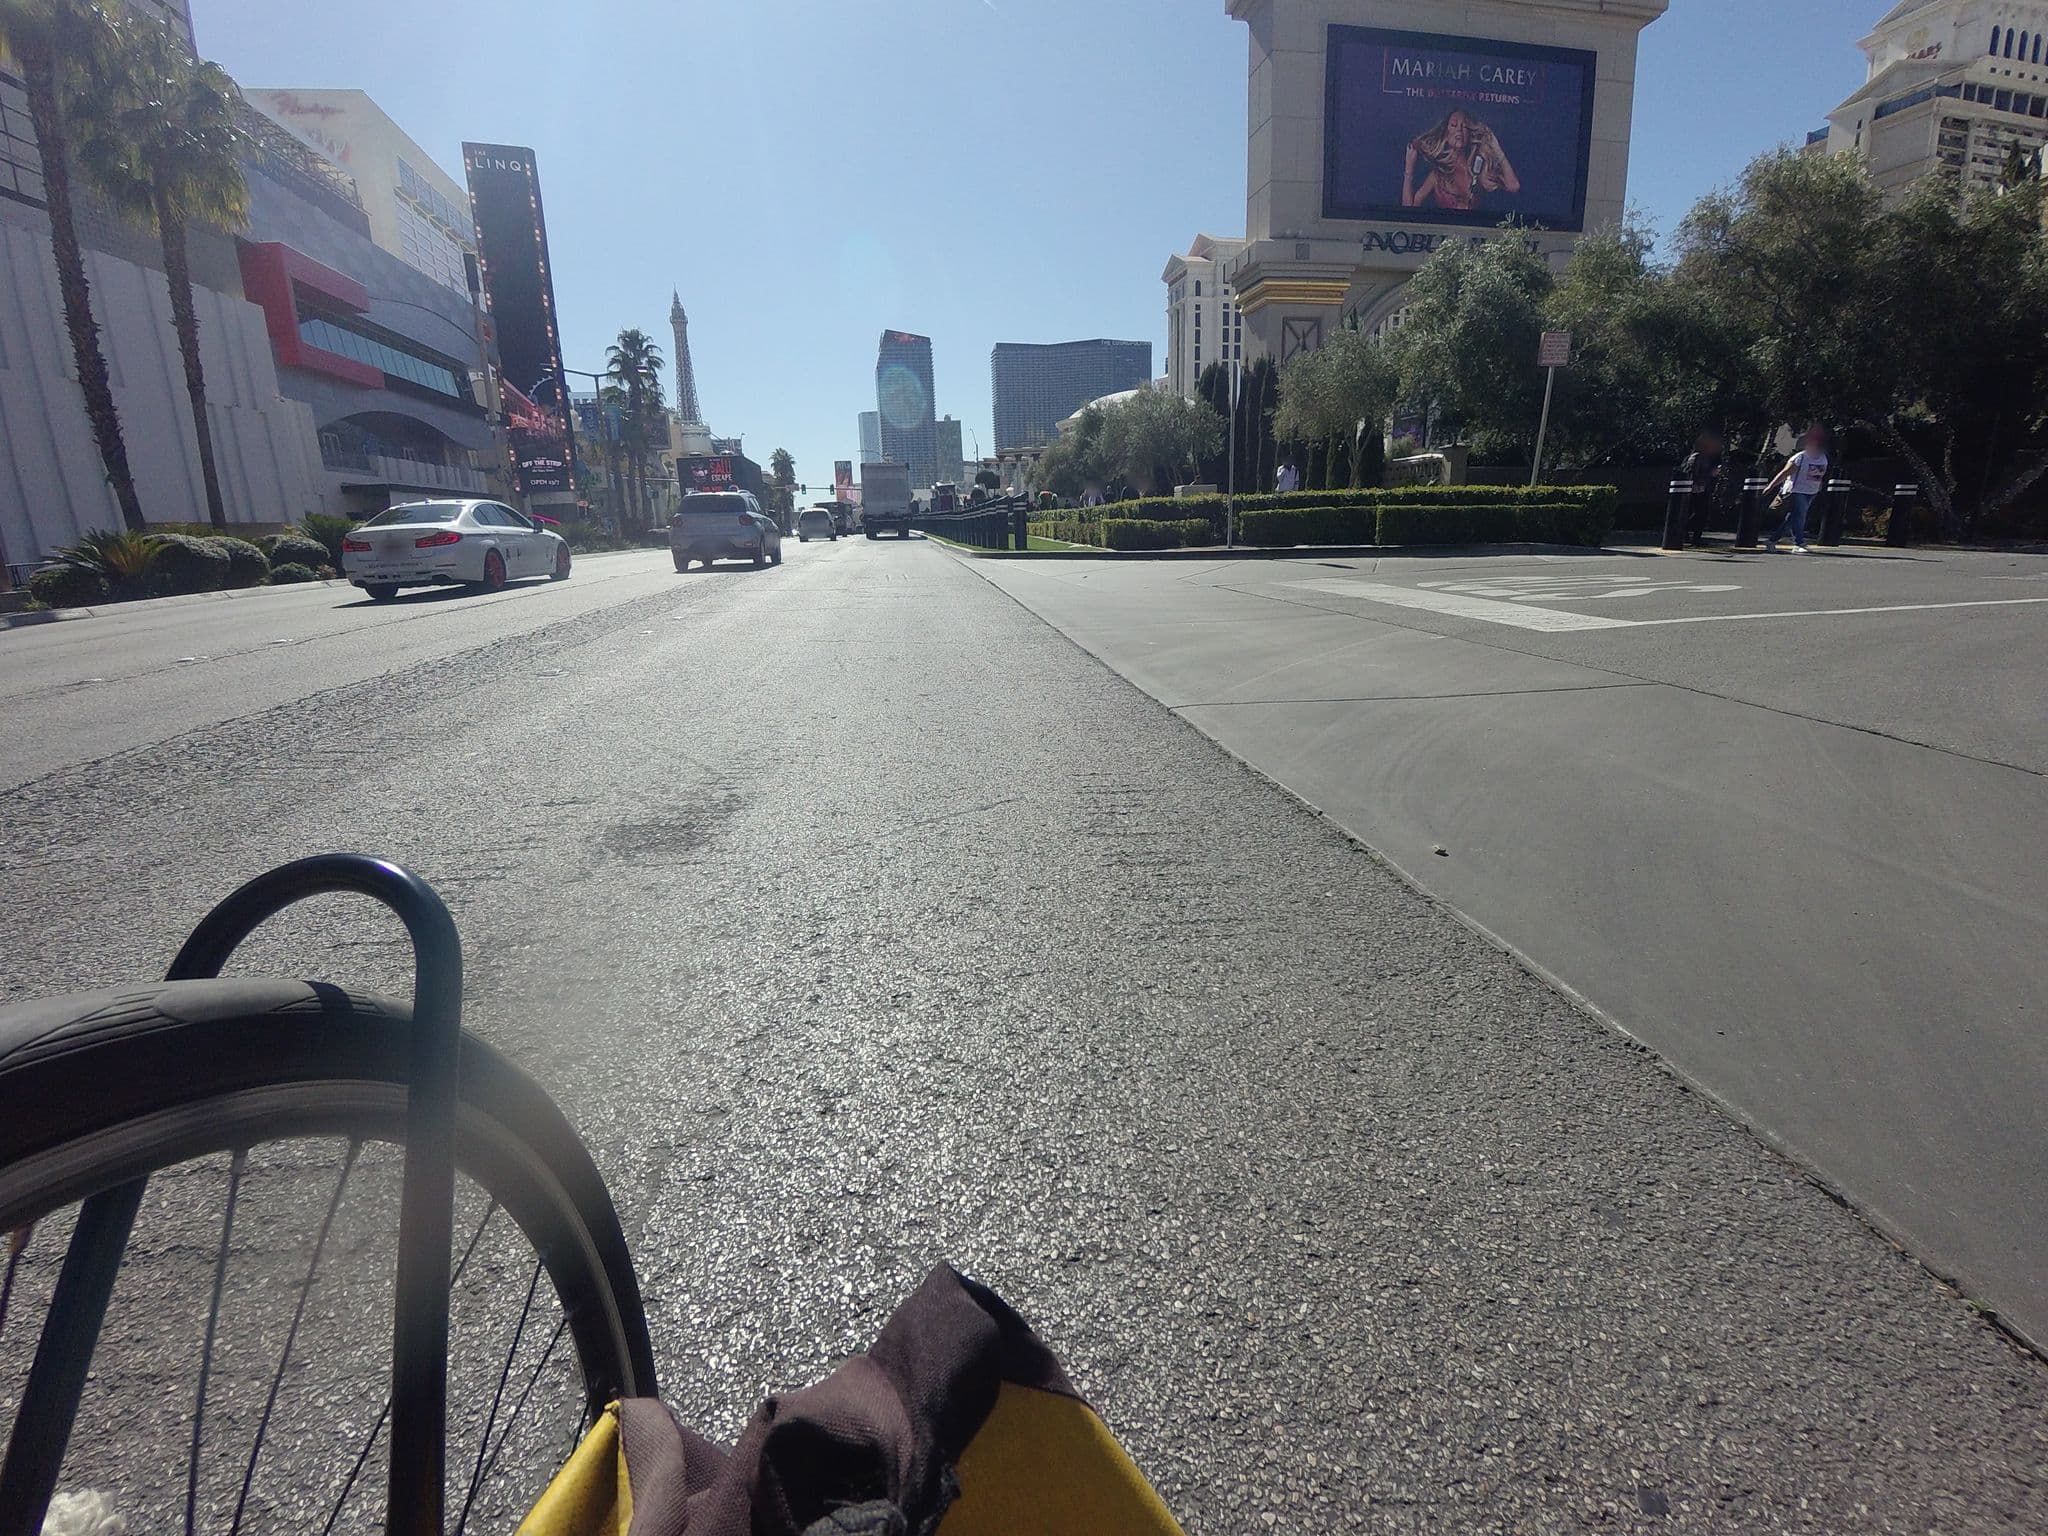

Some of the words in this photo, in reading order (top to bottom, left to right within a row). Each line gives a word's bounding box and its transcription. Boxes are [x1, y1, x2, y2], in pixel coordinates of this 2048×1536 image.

[1392, 58, 1471, 80] MARIAH
[1480, 65, 1537, 86] CAREY
[1406, 87, 1425, 97] THE
[1479, 92, 1520, 104] RETURNS
[474, 157, 522, 172] LINQ
[711, 473, 733, 481] ESCAPE
